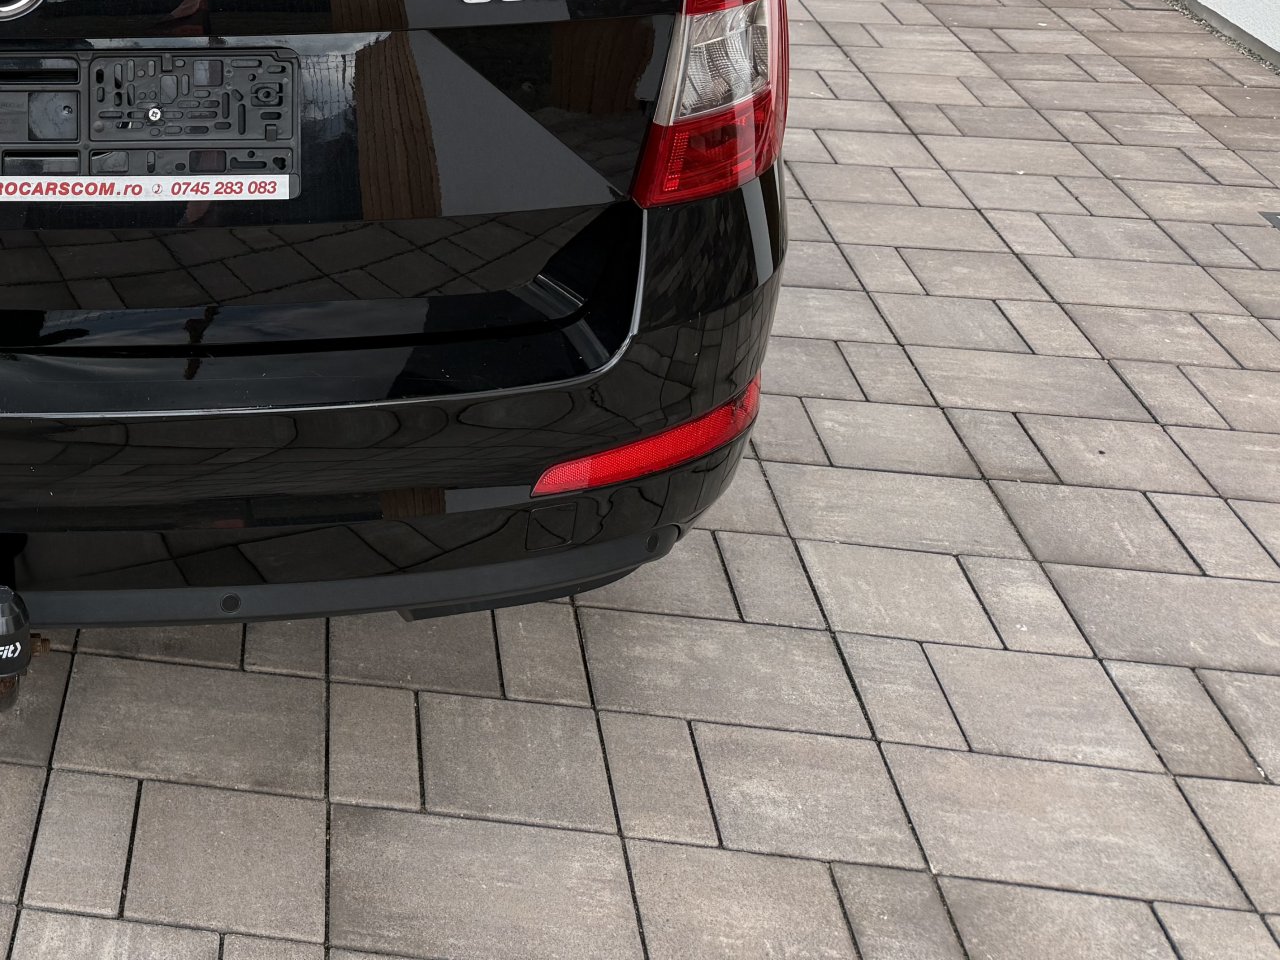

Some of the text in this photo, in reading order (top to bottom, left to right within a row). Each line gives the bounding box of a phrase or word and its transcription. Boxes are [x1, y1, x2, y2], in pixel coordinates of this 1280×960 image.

[170, 181, 210, 195] 0745
[213, 181, 243, 195] 283
[247, 180, 278, 195] 083
